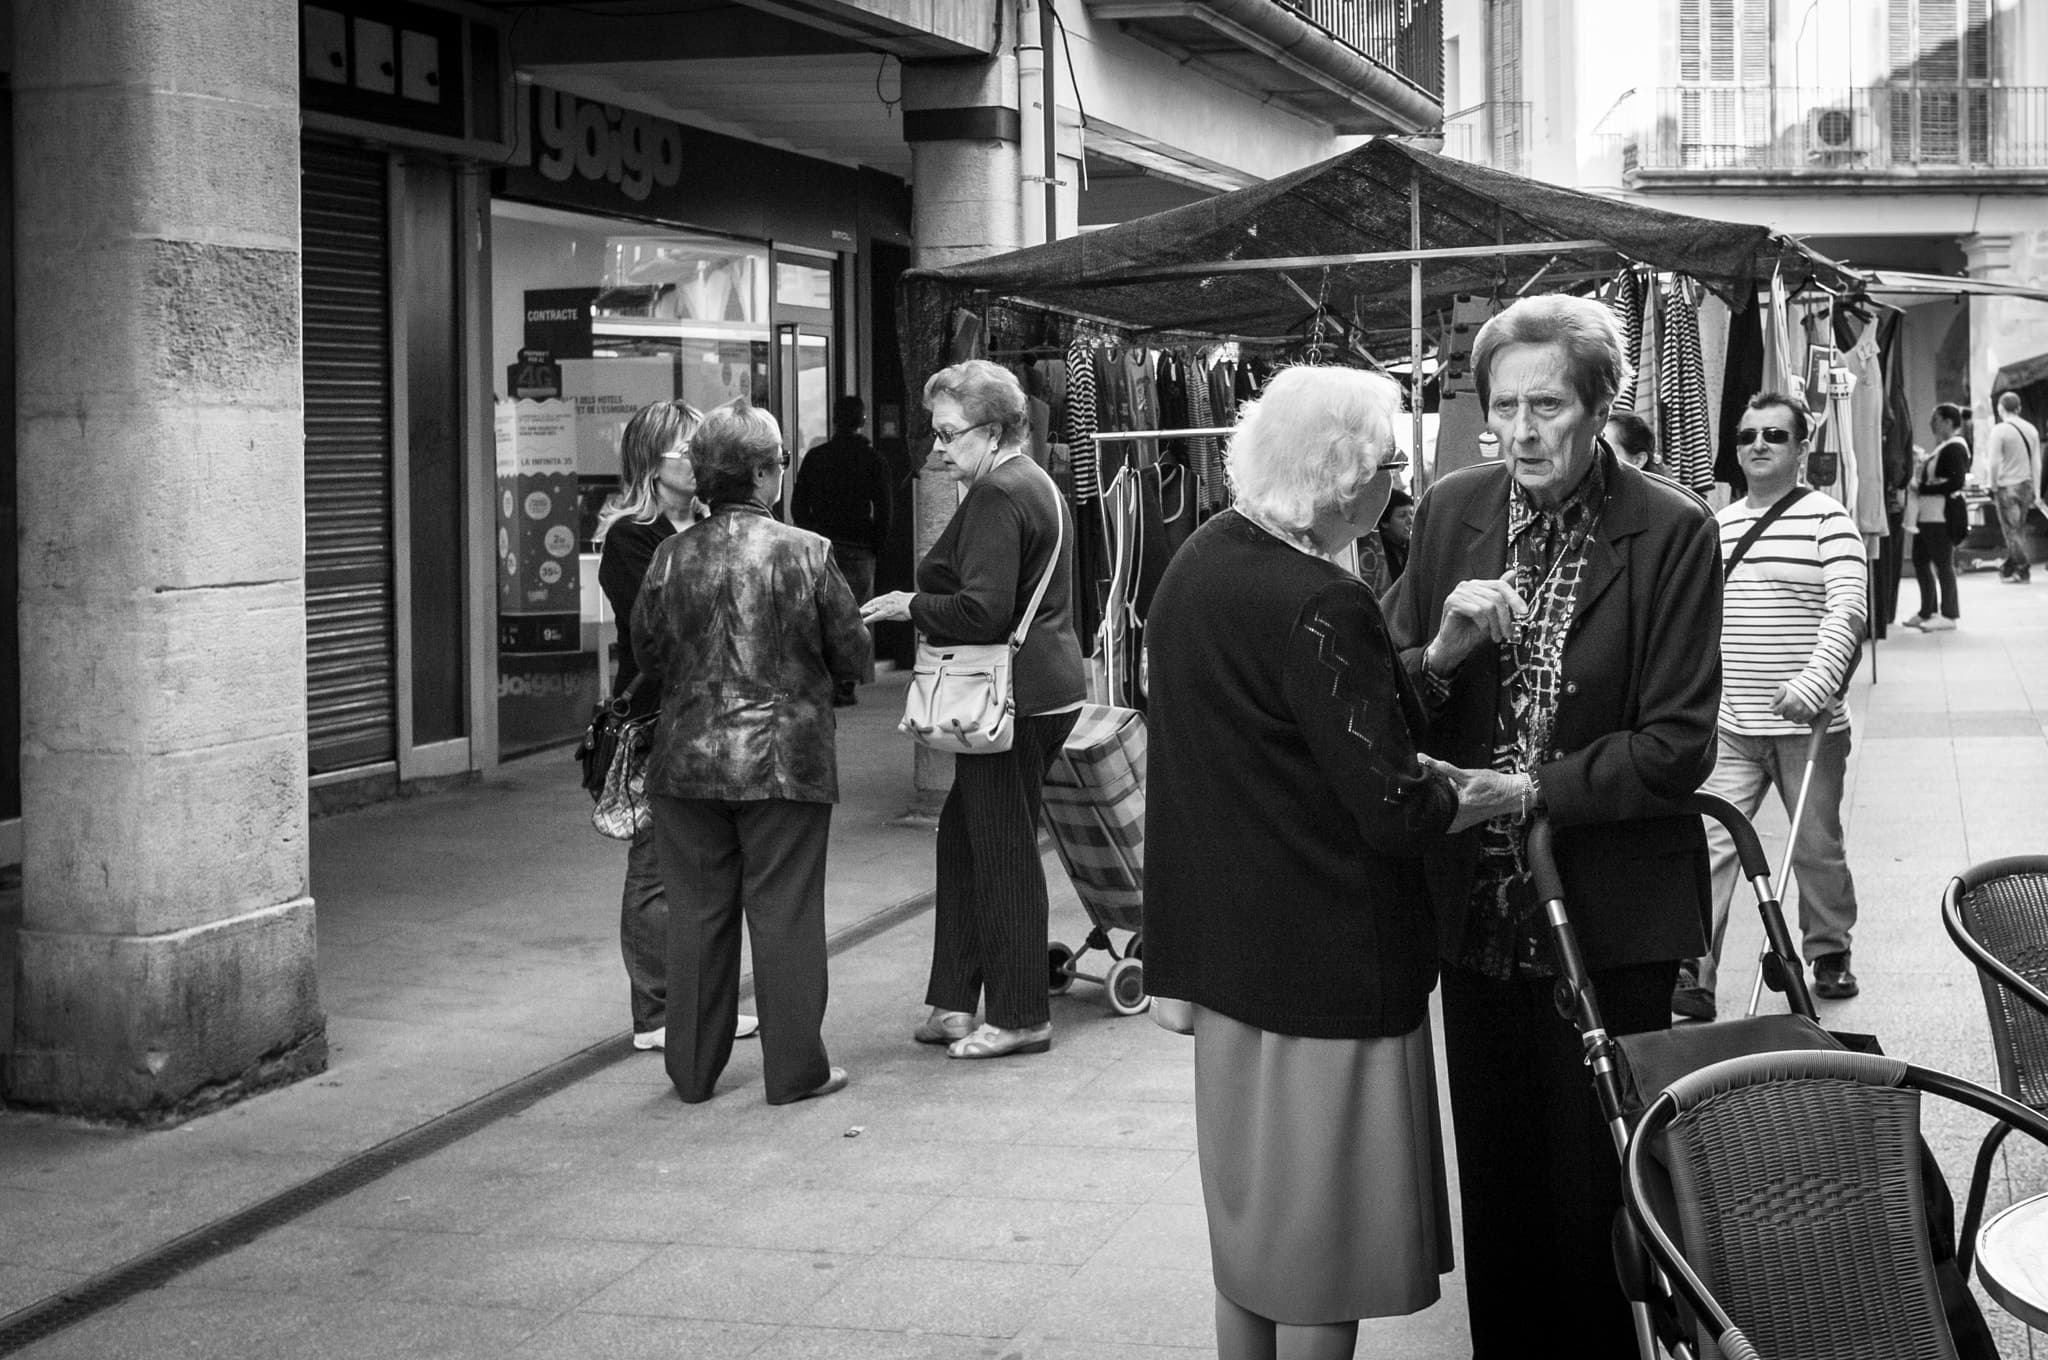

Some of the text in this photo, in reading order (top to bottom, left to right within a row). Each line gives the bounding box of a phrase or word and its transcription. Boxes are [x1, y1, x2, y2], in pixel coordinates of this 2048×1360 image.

[539, 86, 683, 201] yoigo
[527, 309, 578, 322] CONTRACTE
[519, 365, 553, 387] 4G
[597, 395, 623, 404] HOTELS
[520, 458, 531, 467] LA
[564, 456, 573, 465] 35
